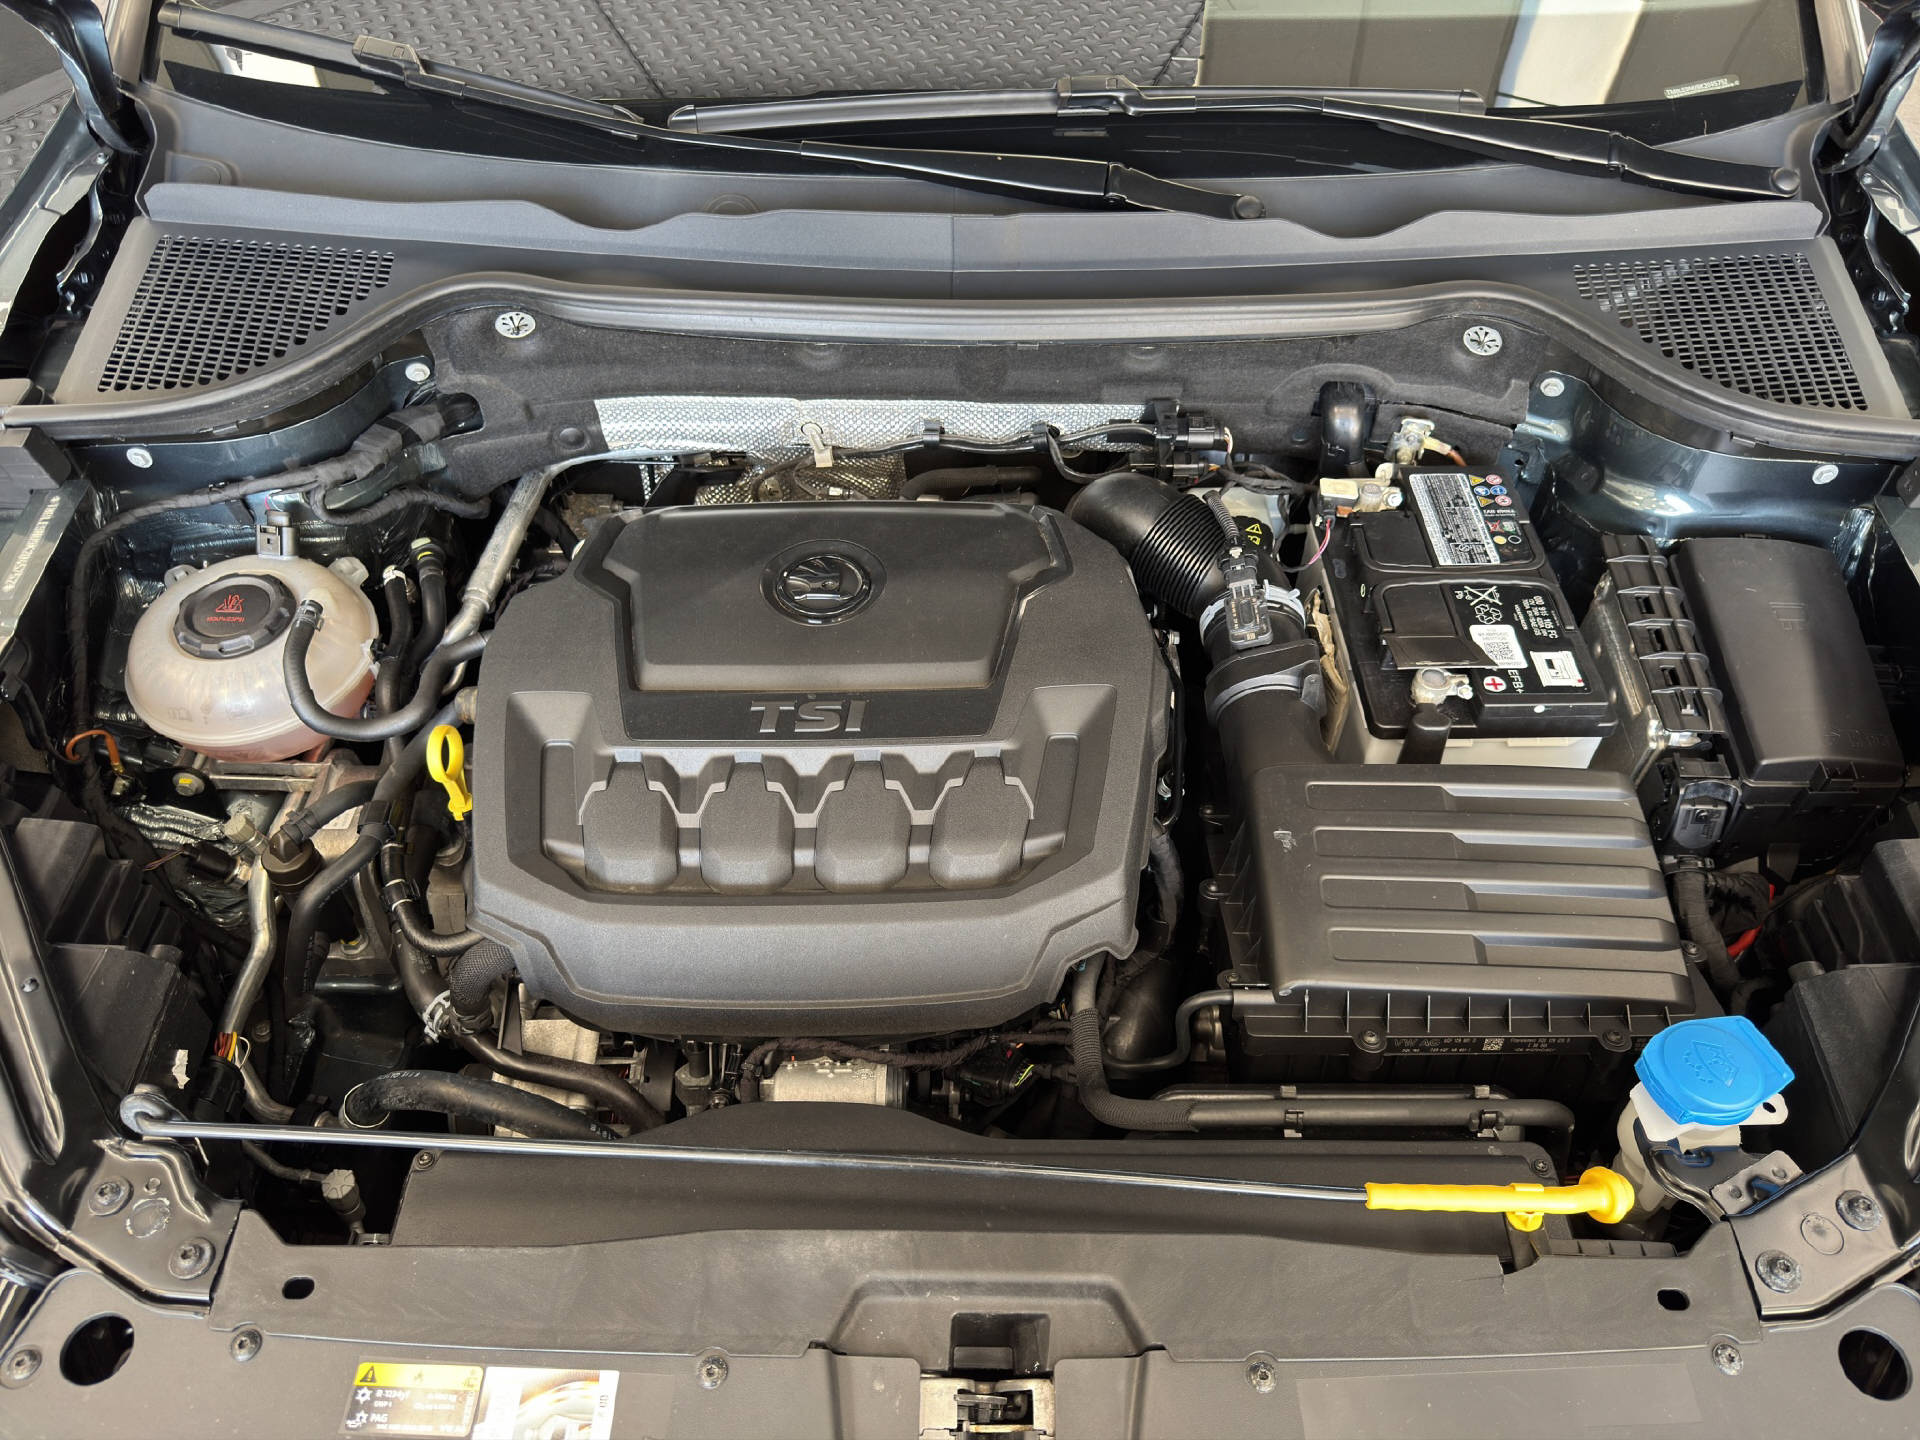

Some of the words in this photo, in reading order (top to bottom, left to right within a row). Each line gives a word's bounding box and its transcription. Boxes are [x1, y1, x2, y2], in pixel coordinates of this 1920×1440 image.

[1507, 669, 1525, 694] EFB+
[750, 700, 869, 734] TSI
[370, 1413, 389, 1423] PAG
